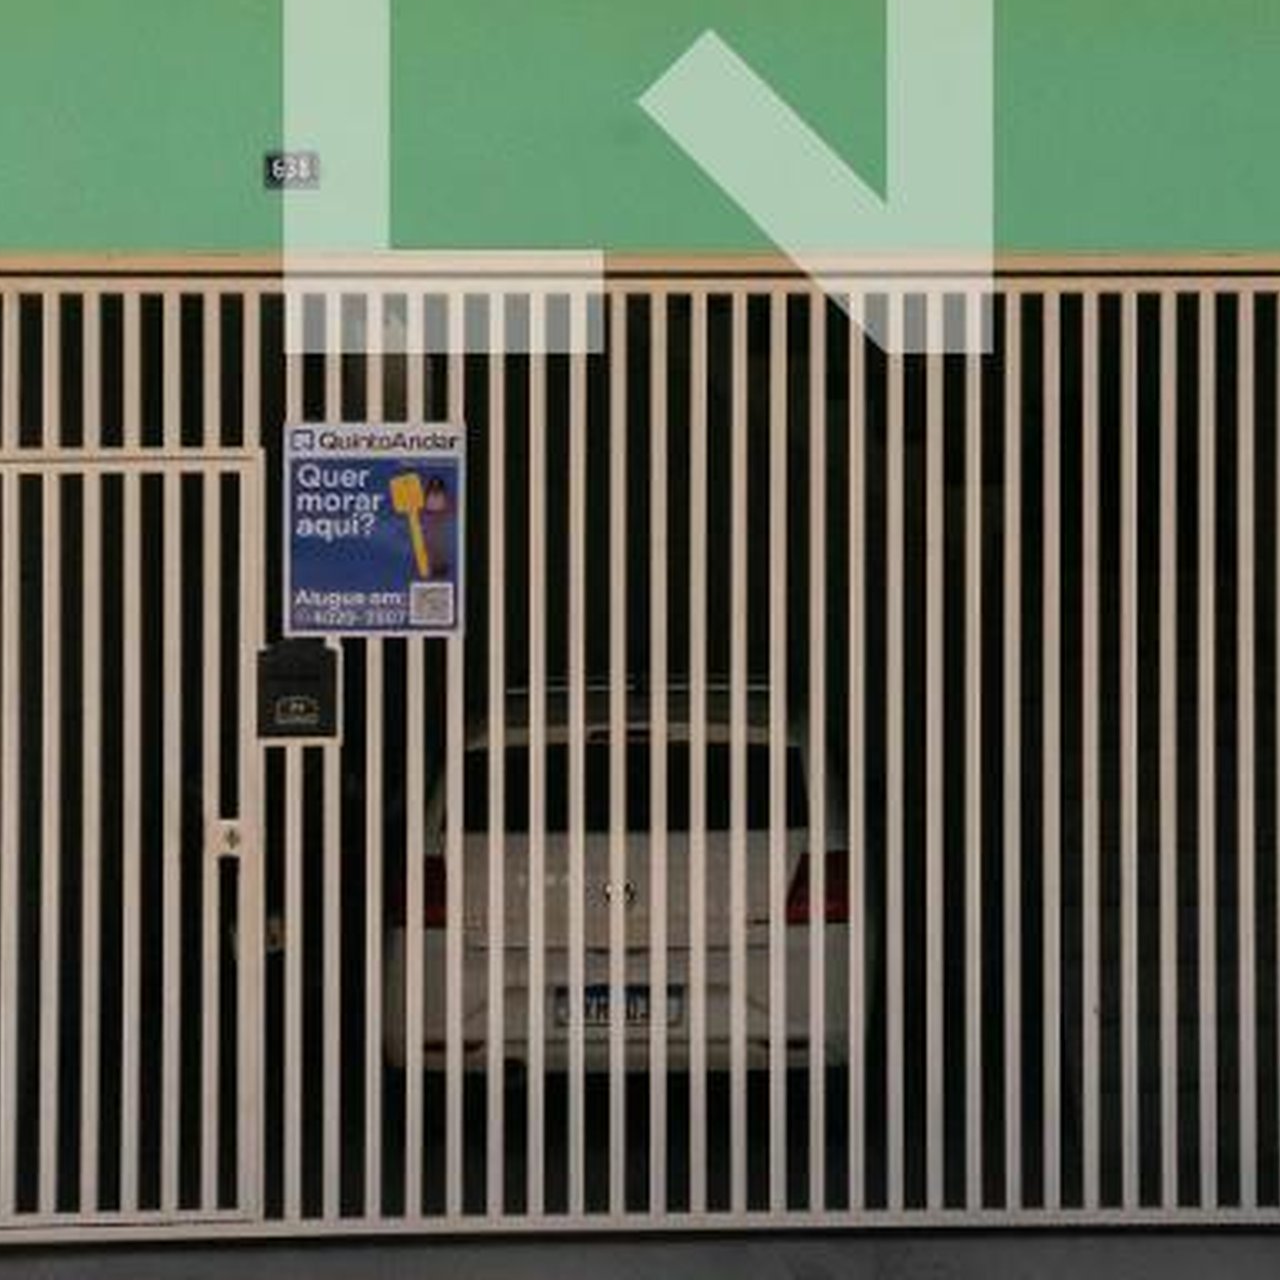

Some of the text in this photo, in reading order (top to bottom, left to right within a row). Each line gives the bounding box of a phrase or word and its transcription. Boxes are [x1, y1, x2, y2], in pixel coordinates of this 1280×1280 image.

[320, 431, 458, 450] QuintoAndar
[297, 464, 370, 488] Quer
[296, 490, 384, 512] morar
[296, 513, 376, 541] aqui?
